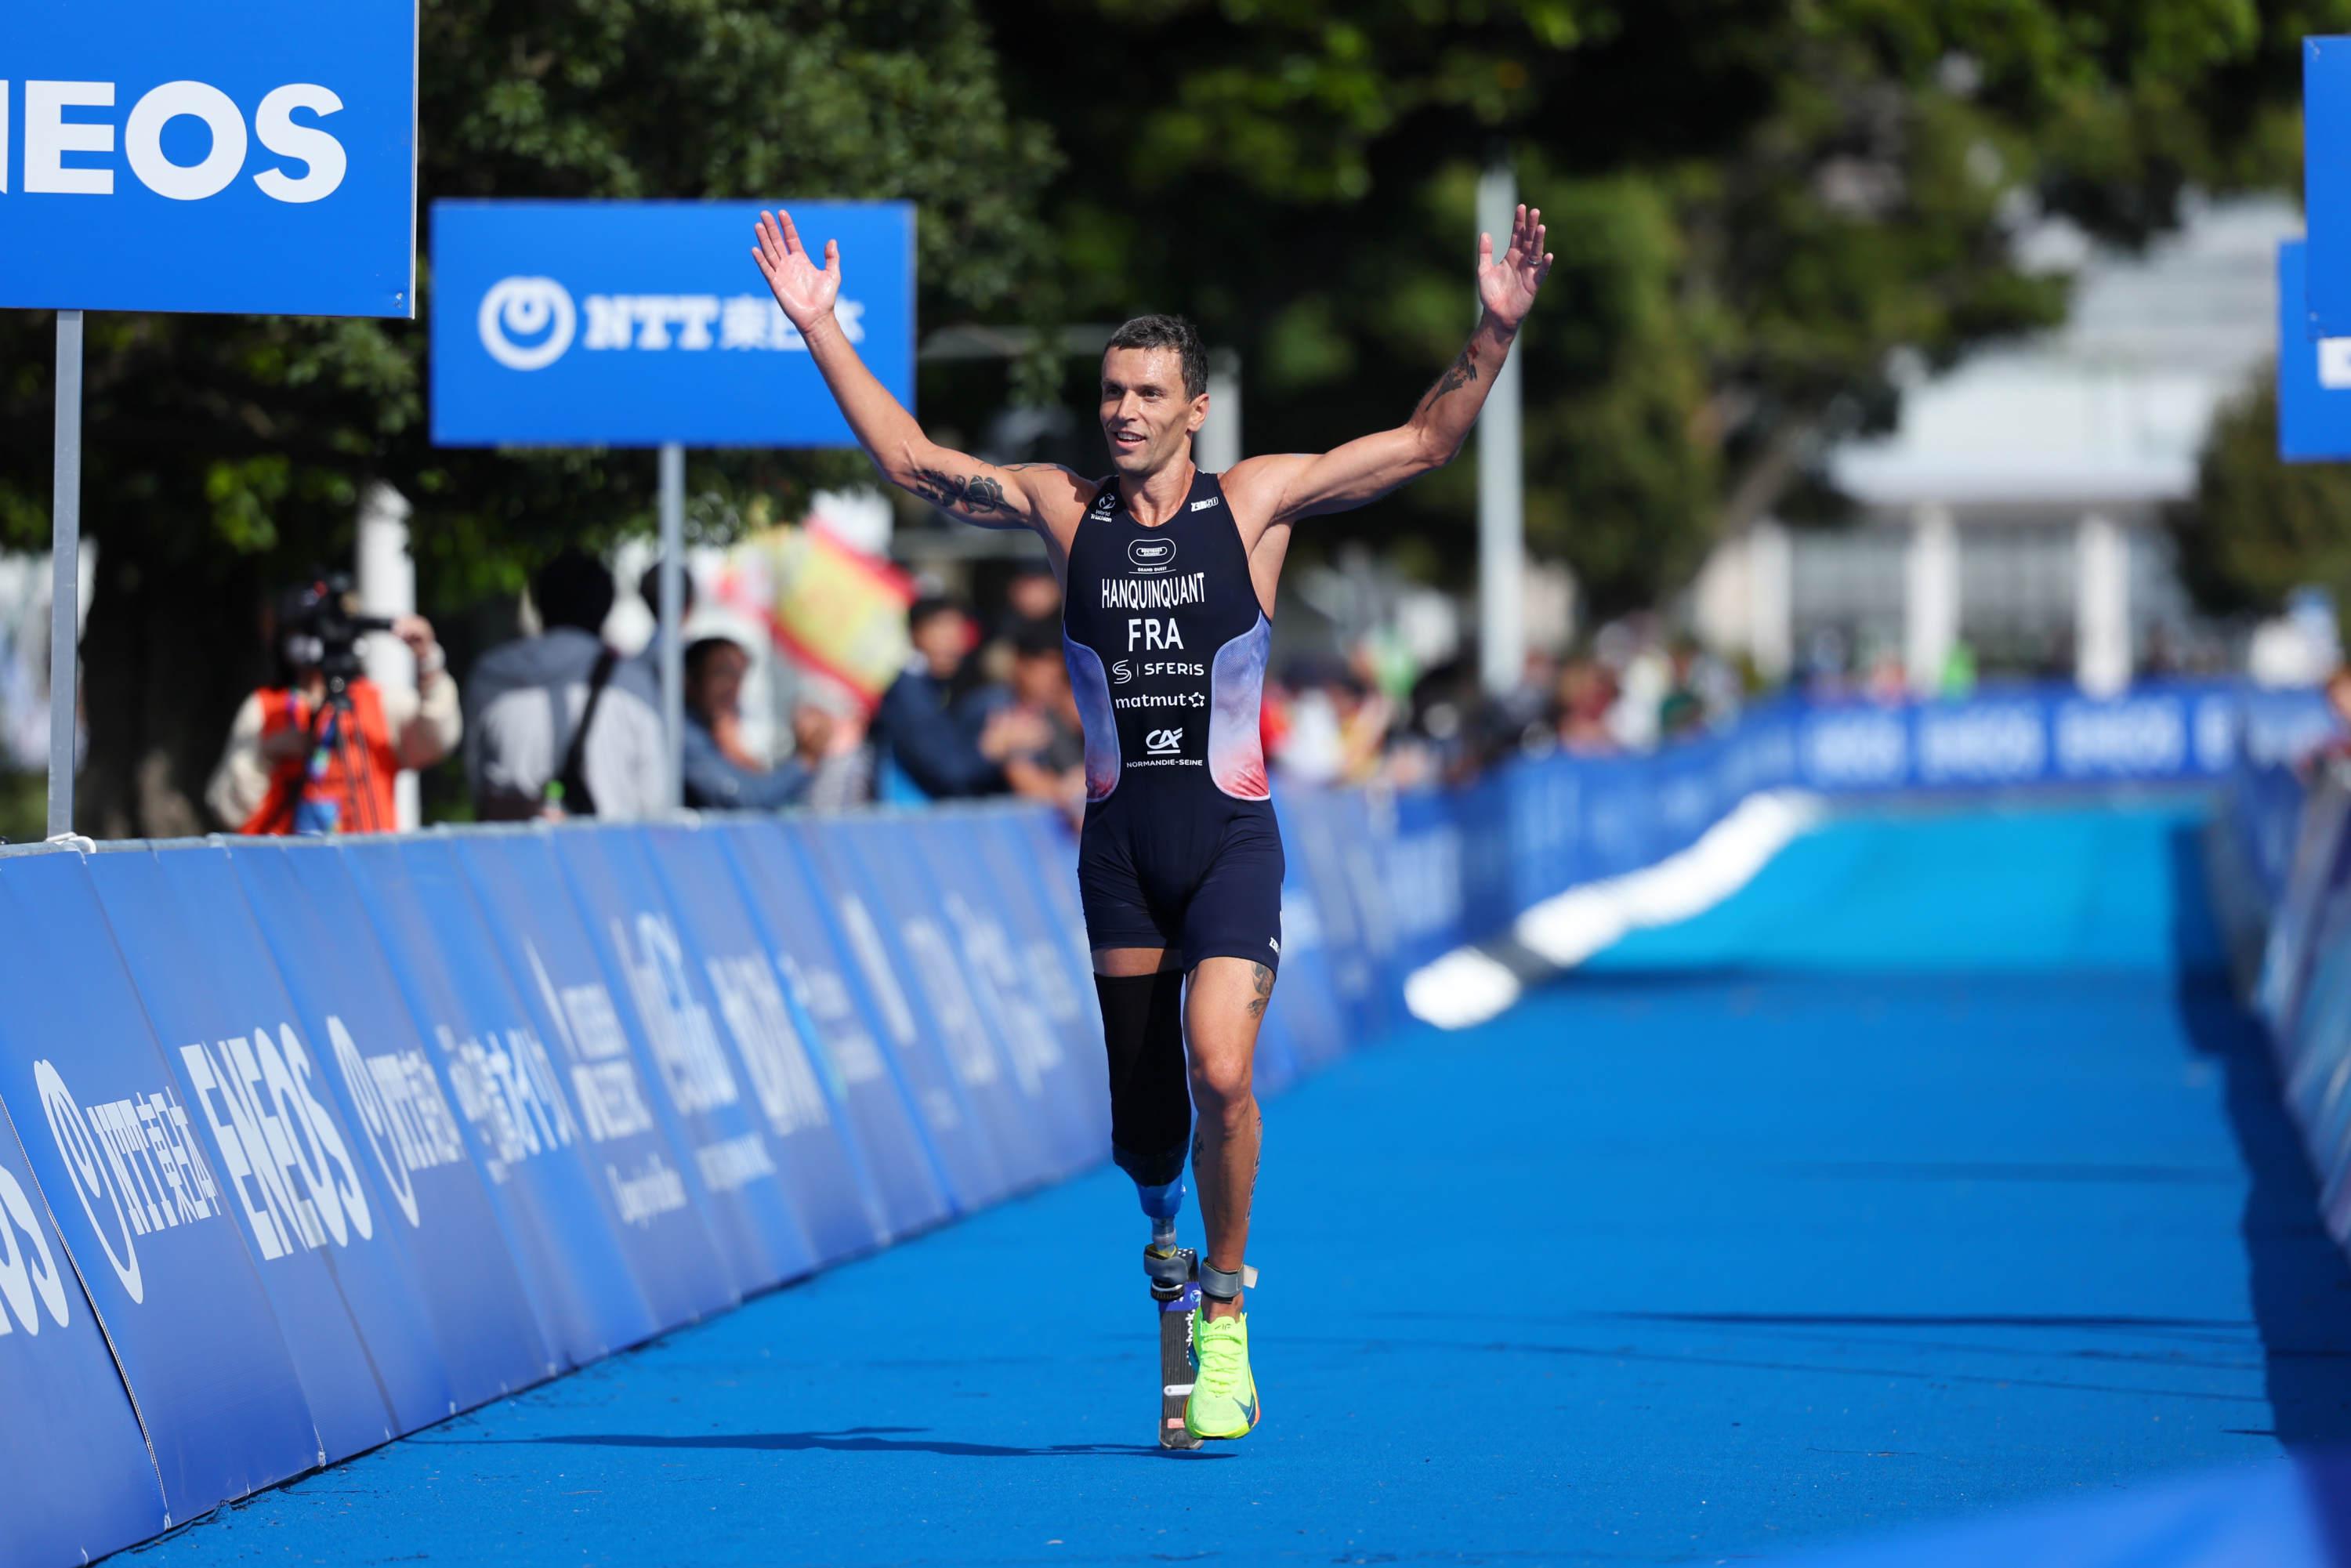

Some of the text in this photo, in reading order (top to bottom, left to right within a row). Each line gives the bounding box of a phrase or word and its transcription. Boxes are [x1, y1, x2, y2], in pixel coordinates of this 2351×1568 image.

[0, 80, 347, 203] EOS
[1102, 572, 1204, 610] HANQUINQUANT
[1128, 617, 1184, 652] FRA
[1115, 693, 1186, 709] matmut
[1126, 759, 1203, 768] NORMANDIE-SEINE
[85, 1085, 222, 1236] NTT東日本
[179, 1022, 373, 1261] ENEOS
